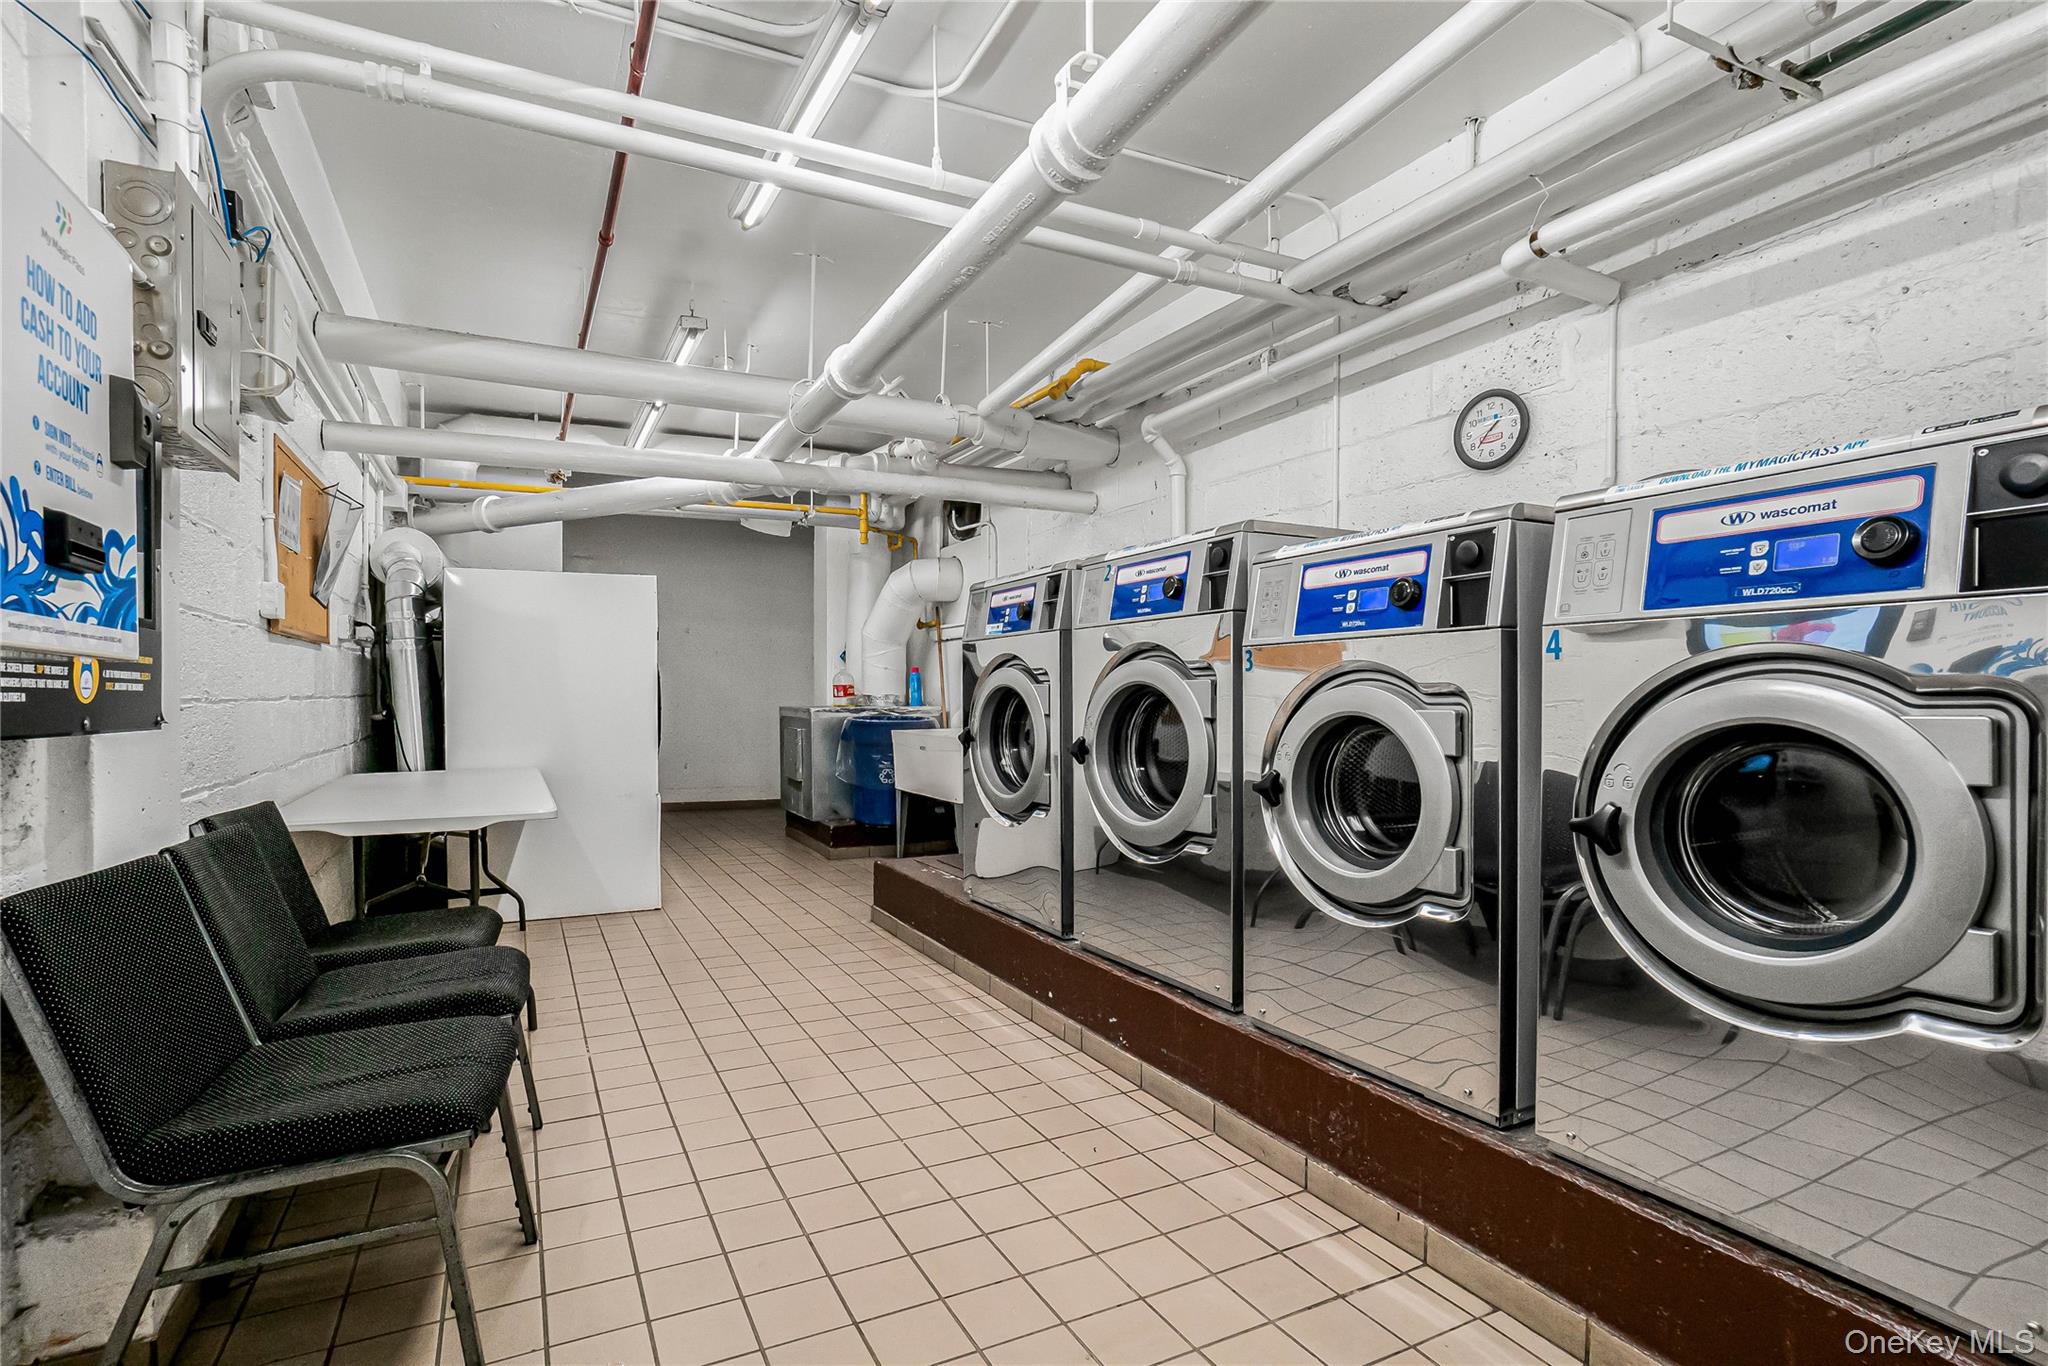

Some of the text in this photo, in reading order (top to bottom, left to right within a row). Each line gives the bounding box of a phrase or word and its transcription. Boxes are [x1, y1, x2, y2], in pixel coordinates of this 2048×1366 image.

[26, 254, 97, 341] HOW TO ADD
[21, 296, 102, 385] CASH TO YOUR
[38, 354, 90, 415] ACCOUNT
[1487, 402, 1496, 410] 12
[1469, 419, 1477, 428] 10
[1511, 419, 1517, 427] 3
[1470, 443, 1476, 451] 8
[1479, 449, 1484, 457] 7
[1489, 449, 1495, 457] 6
[1501, 442, 1507, 450] 5
[1658, 469, 1712, 486] DOWNLOAD
[1733, 445, 1841, 473] MYMAGICPASS
[1843, 439, 1870, 452] APP
[1760, 500, 1838, 521] wascomat
[1104, 564, 1112, 582] 2
[1353, 564, 1390, 576] wascomat
[1545, 629, 1562, 660] 4
[1245, 649, 1253, 671] 3
